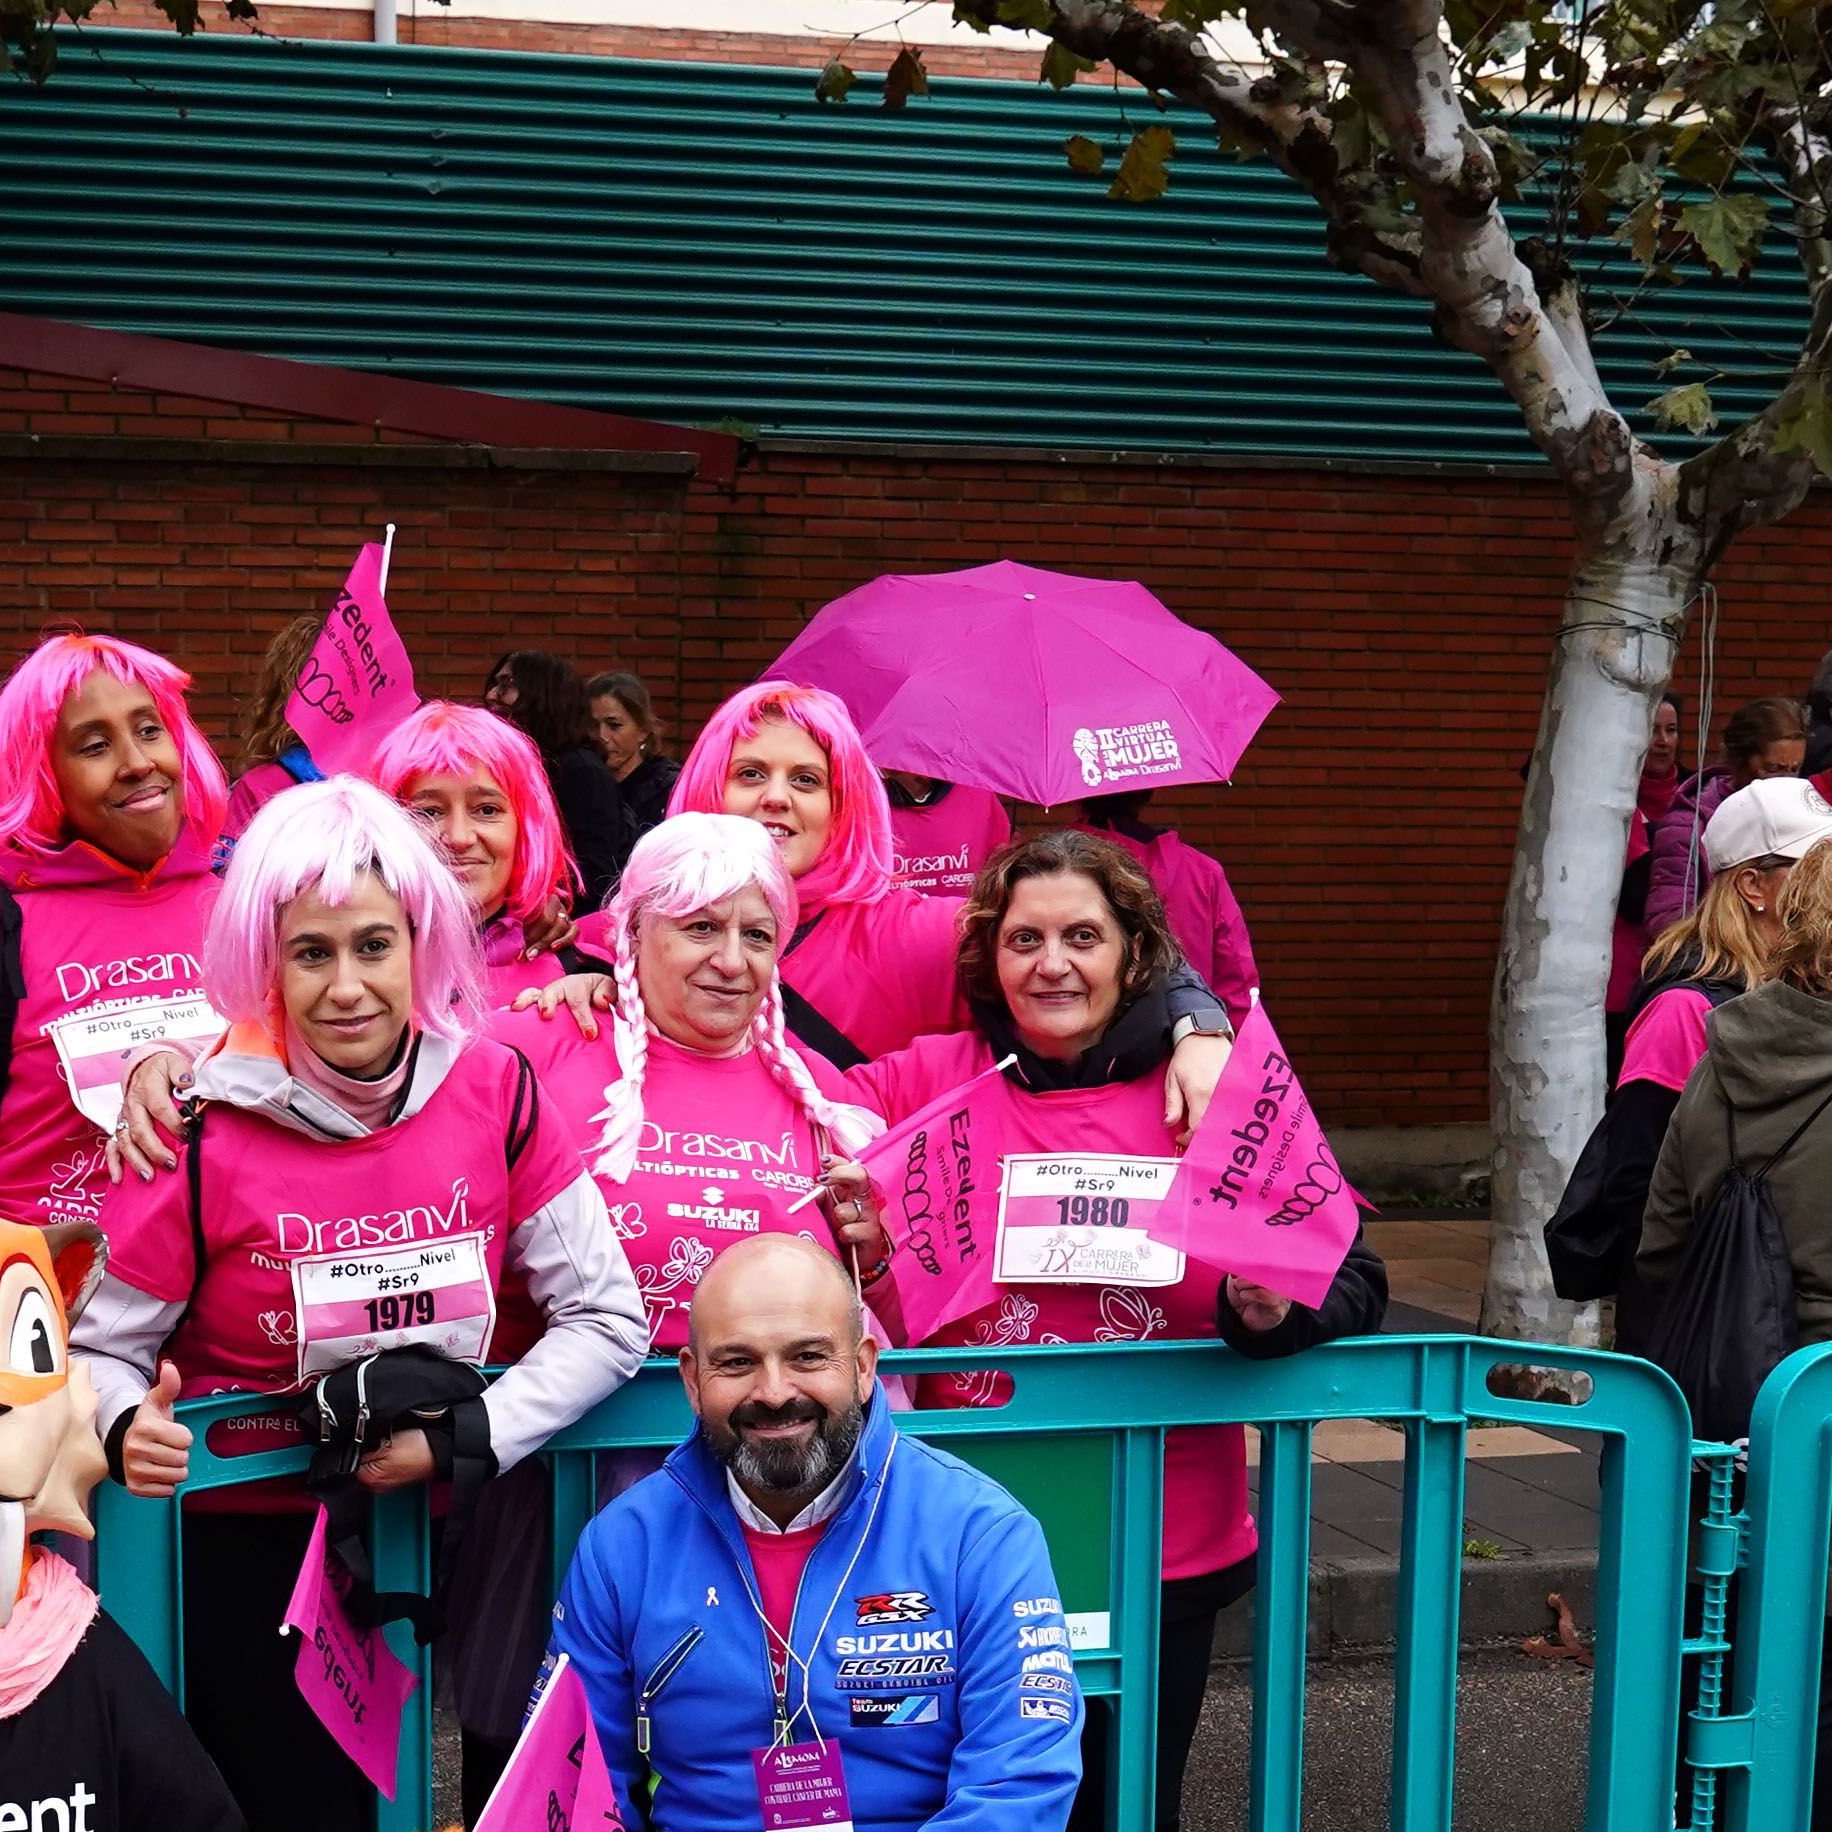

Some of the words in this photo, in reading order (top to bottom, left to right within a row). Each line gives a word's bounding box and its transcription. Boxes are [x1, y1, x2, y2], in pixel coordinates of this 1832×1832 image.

[1112, 719, 1171, 737] CARRERA
[1115, 730, 1174, 747] VIRTUAL
[1109, 739, 1180, 767] MUJER
[637, 1121, 799, 1168] Drasanvi
[1074, 1179, 1115, 1192] #Sr9
[277, 1177, 470, 1253] Drasanvi
[667, 1203, 760, 1224] SUZUKI
[1056, 1196, 1130, 1228] 1980
[1095, 1259, 1139, 1273] MUJER
[378, 1273, 420, 1291] #Sr9
[364, 1290, 435, 1332] 1979
[227, 1418, 281, 1430] CONTRA
[284, 1419, 301, 1432] EL
[835, 1630, 954, 1655] SUZUKI
[836, 1655, 953, 1678] ECSTAR
[852, 1704, 901, 1713] SUZUKI
